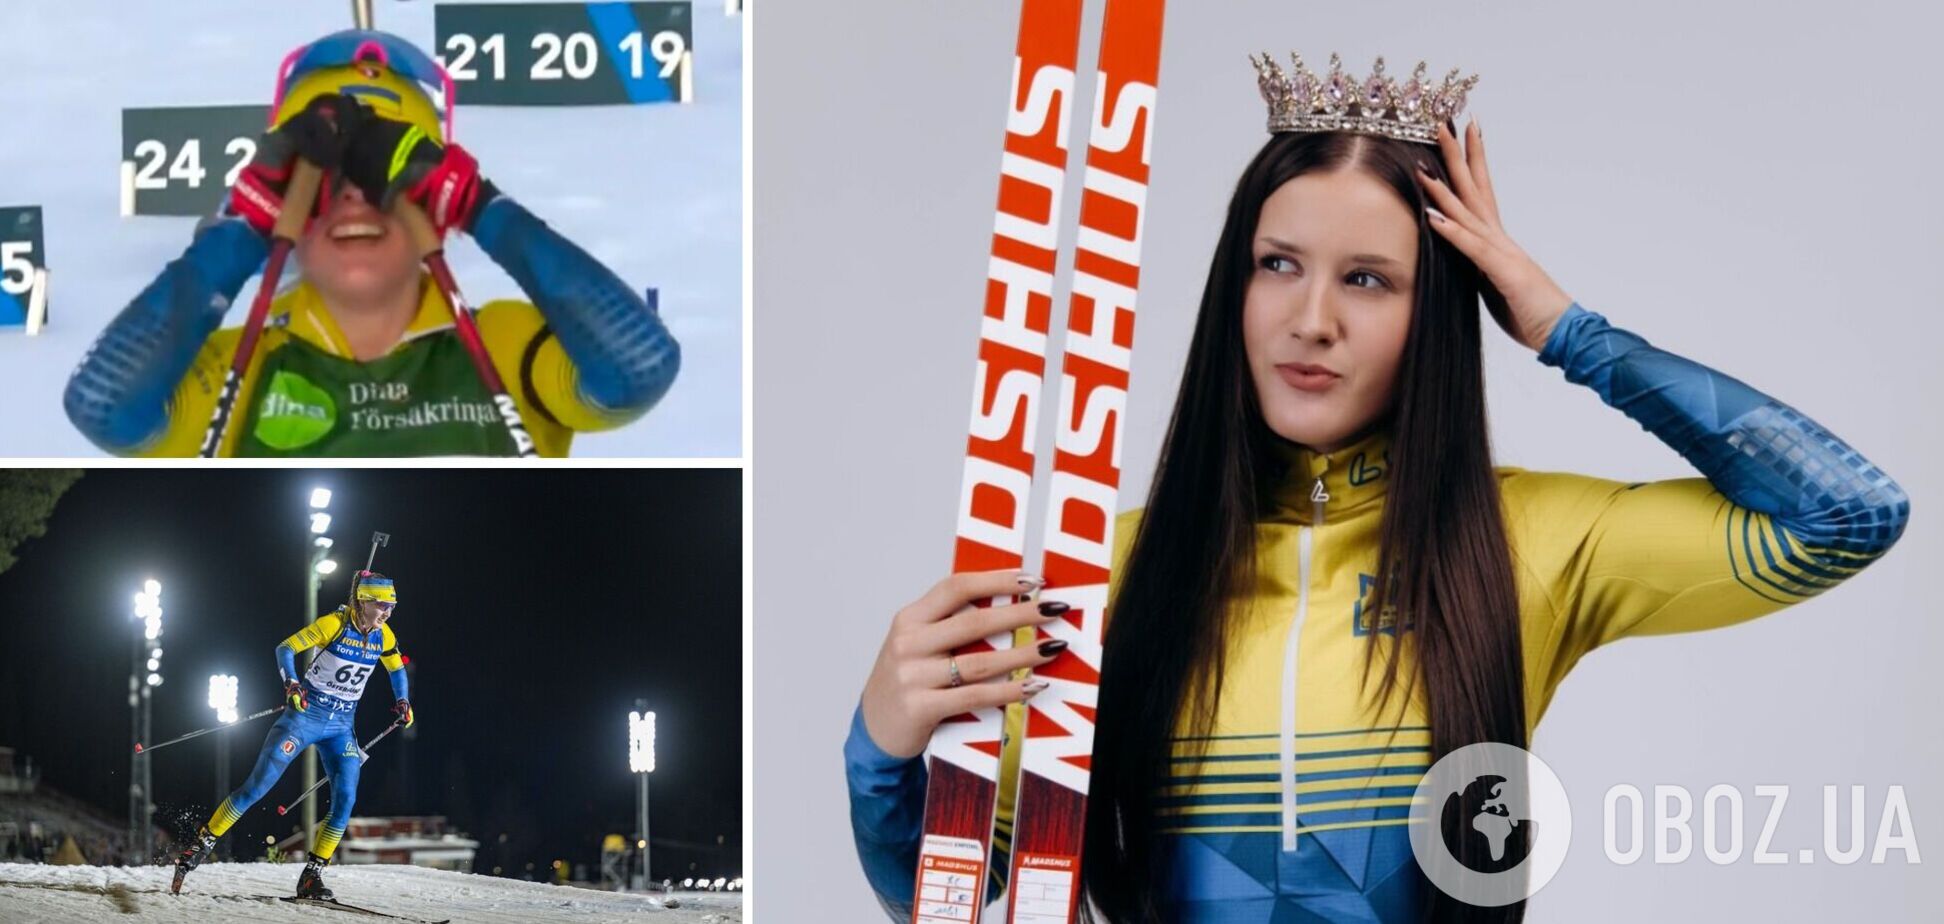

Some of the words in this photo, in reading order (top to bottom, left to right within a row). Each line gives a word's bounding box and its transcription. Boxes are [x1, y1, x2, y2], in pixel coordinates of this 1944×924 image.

[445, 33, 506, 80] 21
[530, 32, 598, 79] 20
[618, 31, 685, 79] 19
[133, 139, 206, 189] 24
[224, 137, 257, 187] 2
[0, 241, 35, 295] 5
[494, 394, 540, 457] MA
[1020, 70, 1158, 796] MADSHUS
[335, 664, 371, 686] 65
[336, 644, 353, 656] Tore
